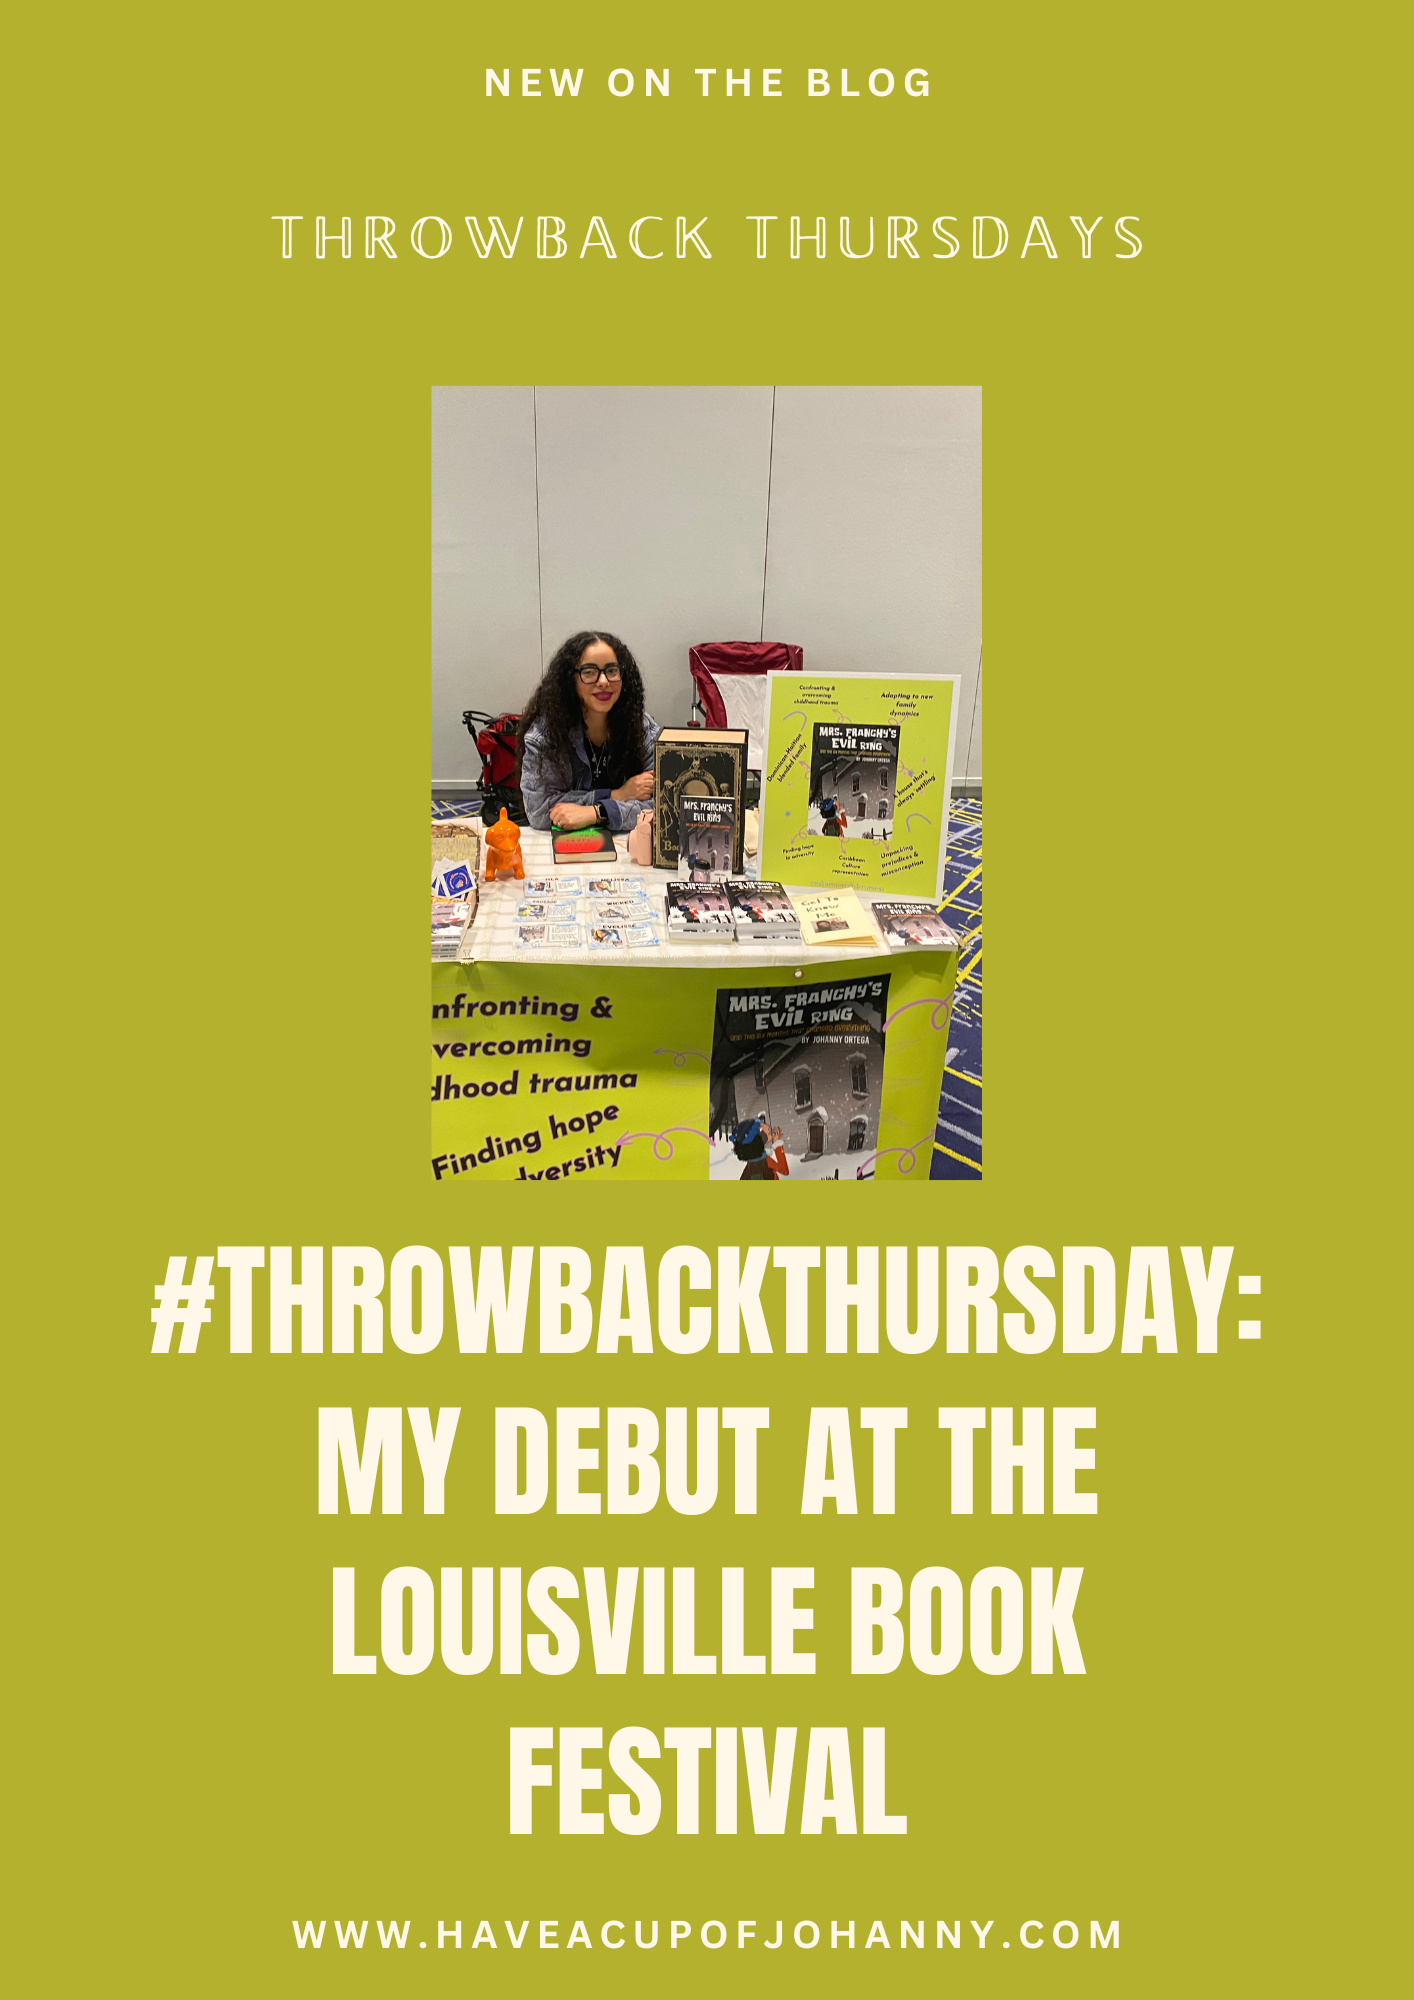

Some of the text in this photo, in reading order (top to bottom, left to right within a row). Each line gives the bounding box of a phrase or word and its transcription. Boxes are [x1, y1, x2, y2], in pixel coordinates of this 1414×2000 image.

[881, 692, 910, 700] Adapting
[890, 709, 919, 717] dynamics
[896, 701, 916, 709] family
[819, 726, 843, 737] MRS.
[767, 733, 802, 782] Dominican-Haitian
[777, 743, 807, 783] blended family
[897, 782, 913, 796] house
[913, 770, 928, 783] that's
[897, 792, 915, 807] always
[880, 845, 913, 858] Unpacking
[881, 855, 912, 868] prejudices
[881, 860, 924, 877] misconception
[801, 898, 821, 906] Get
[806, 904, 838, 913] Know
[432, 993, 614, 1022] nfronting &
[729, 995, 778, 1013] MRS.
[811, 1007, 853, 1024] RING
[432, 1032, 592, 1059] vercoming
[801, 1036, 870, 1045] BY JOHANNY ORTEGA
[431, 1069, 638, 1101] dhood trauma
[431, 1105, 620, 1180] Finding hope
